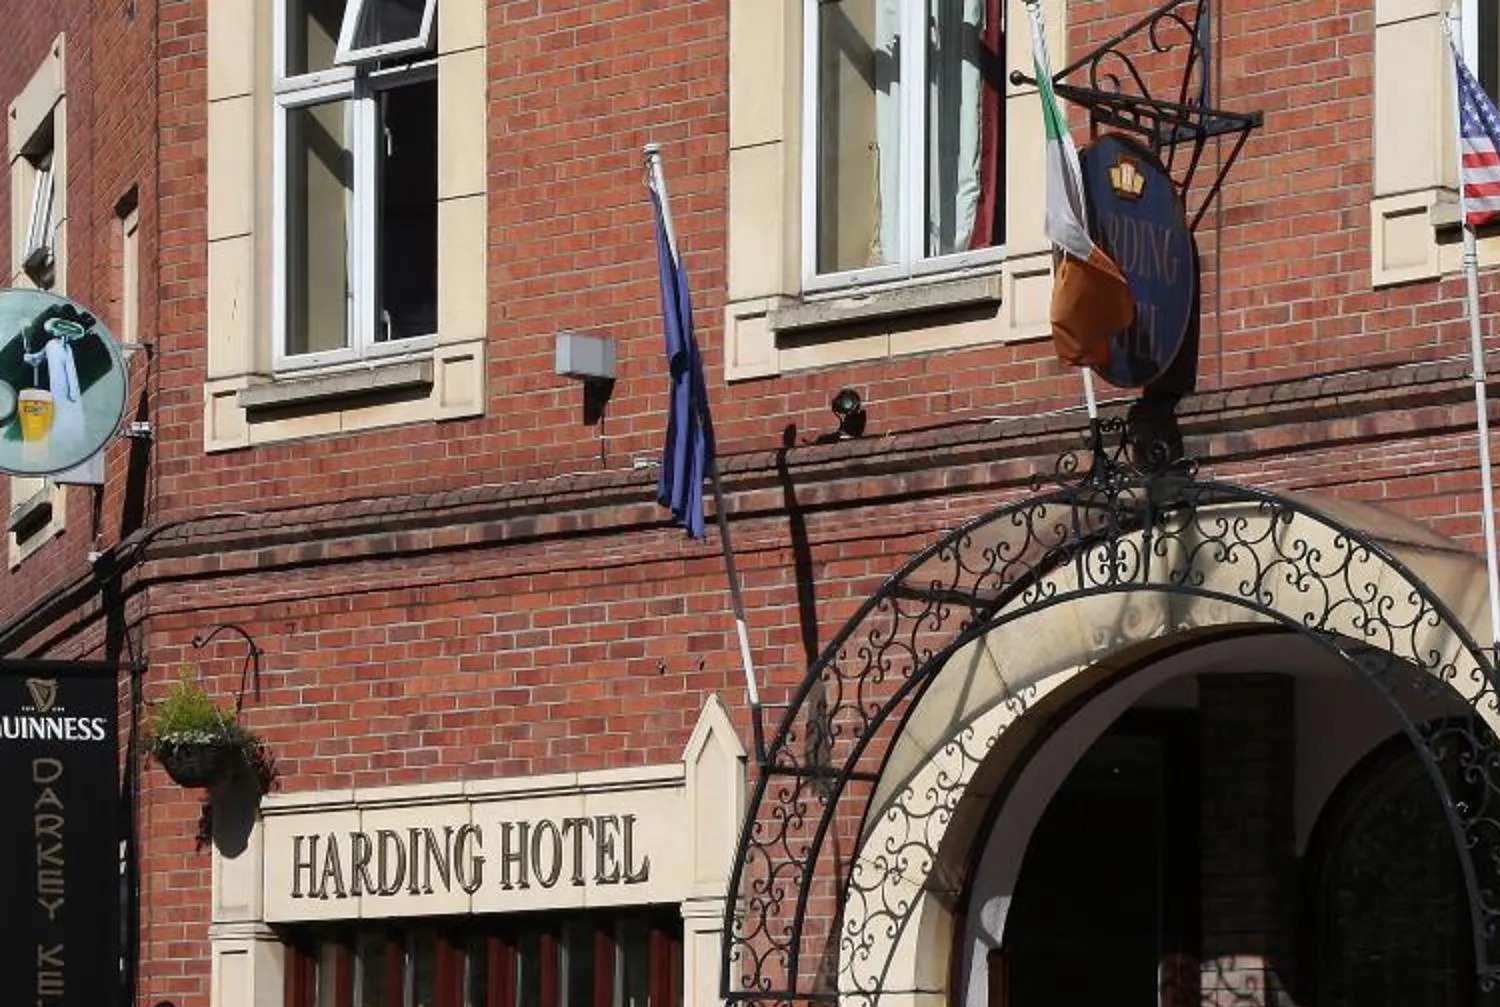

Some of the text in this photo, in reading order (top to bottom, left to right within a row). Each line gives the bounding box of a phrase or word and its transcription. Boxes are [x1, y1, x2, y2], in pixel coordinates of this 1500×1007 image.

[0, 715, 106, 741] UINNESS
[32, 757, 65, 921] DARKEY
[291, 814, 650, 900] HARDING HOTEL
